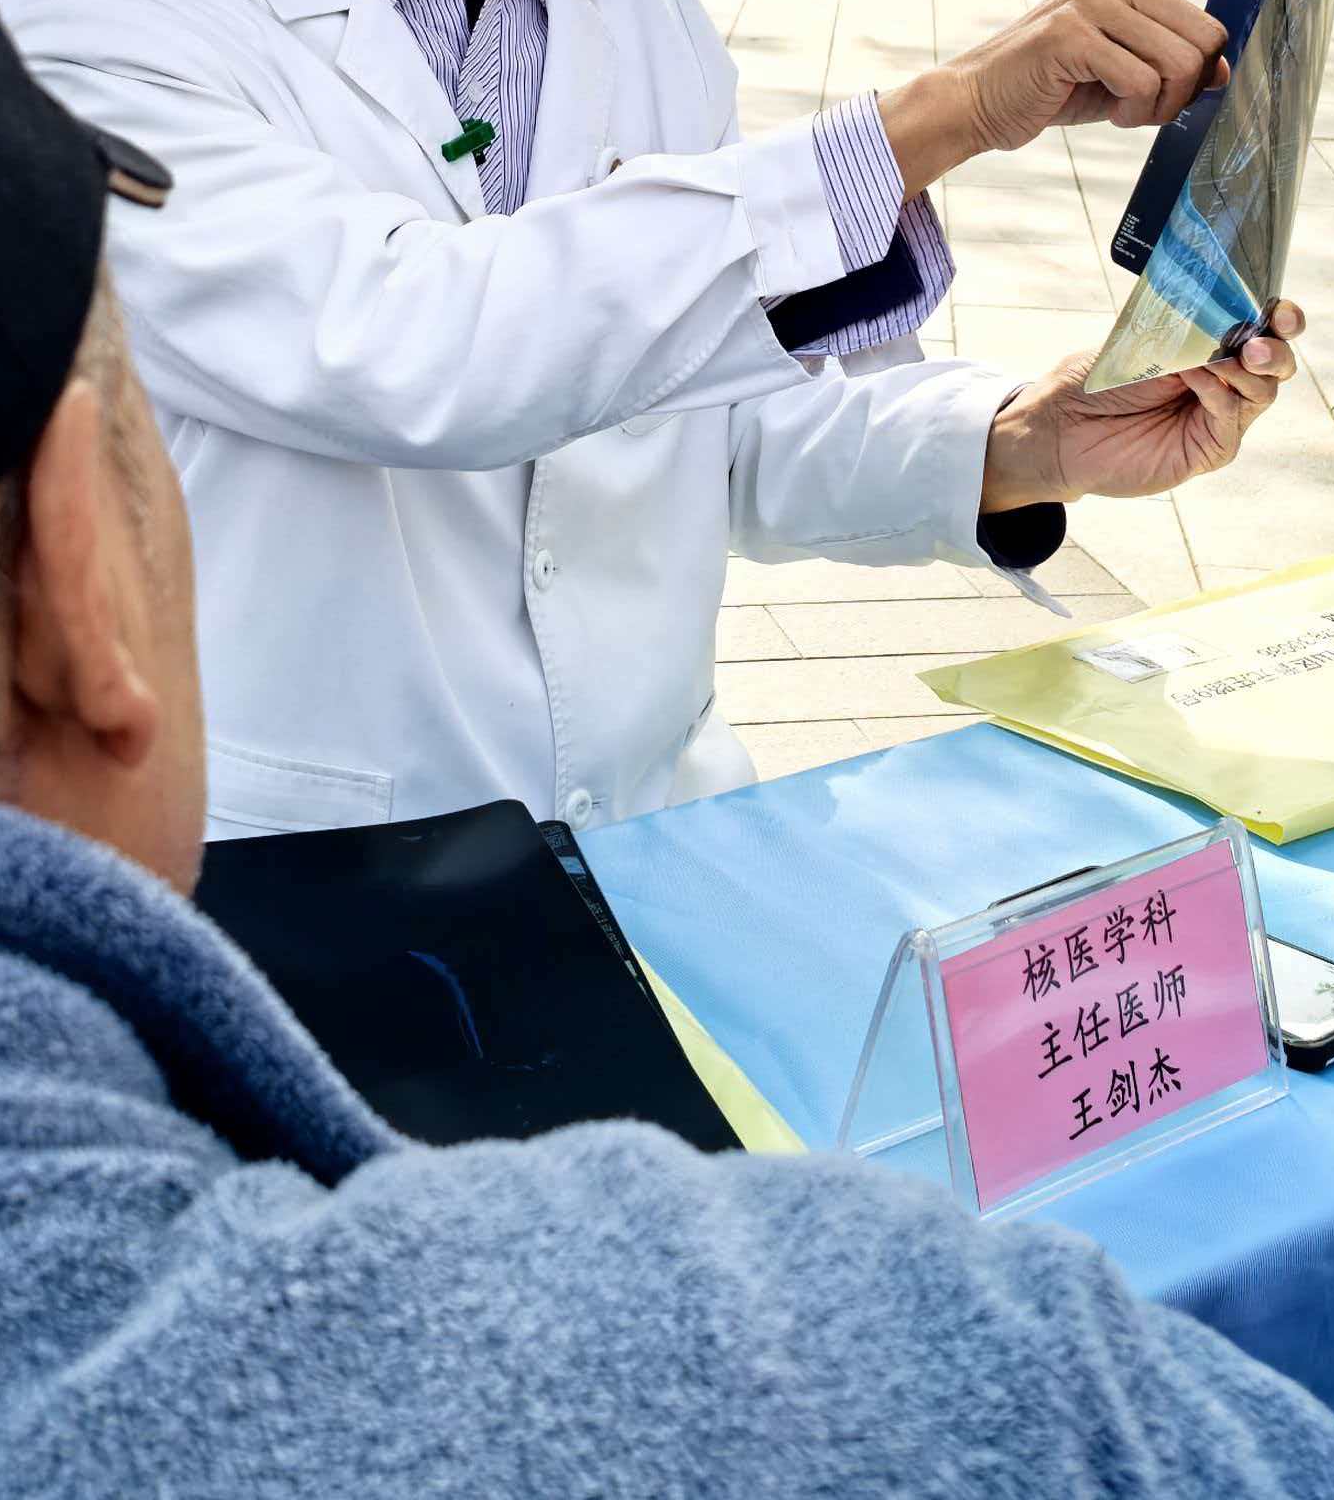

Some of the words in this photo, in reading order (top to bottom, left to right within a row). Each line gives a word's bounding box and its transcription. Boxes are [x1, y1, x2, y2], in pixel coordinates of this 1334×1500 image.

[1022, 889, 1177, 1002] 核医学科
[1037, 964, 1188, 1080] 主任医师
[1069, 1047, 1182, 1141] 王剑杰
